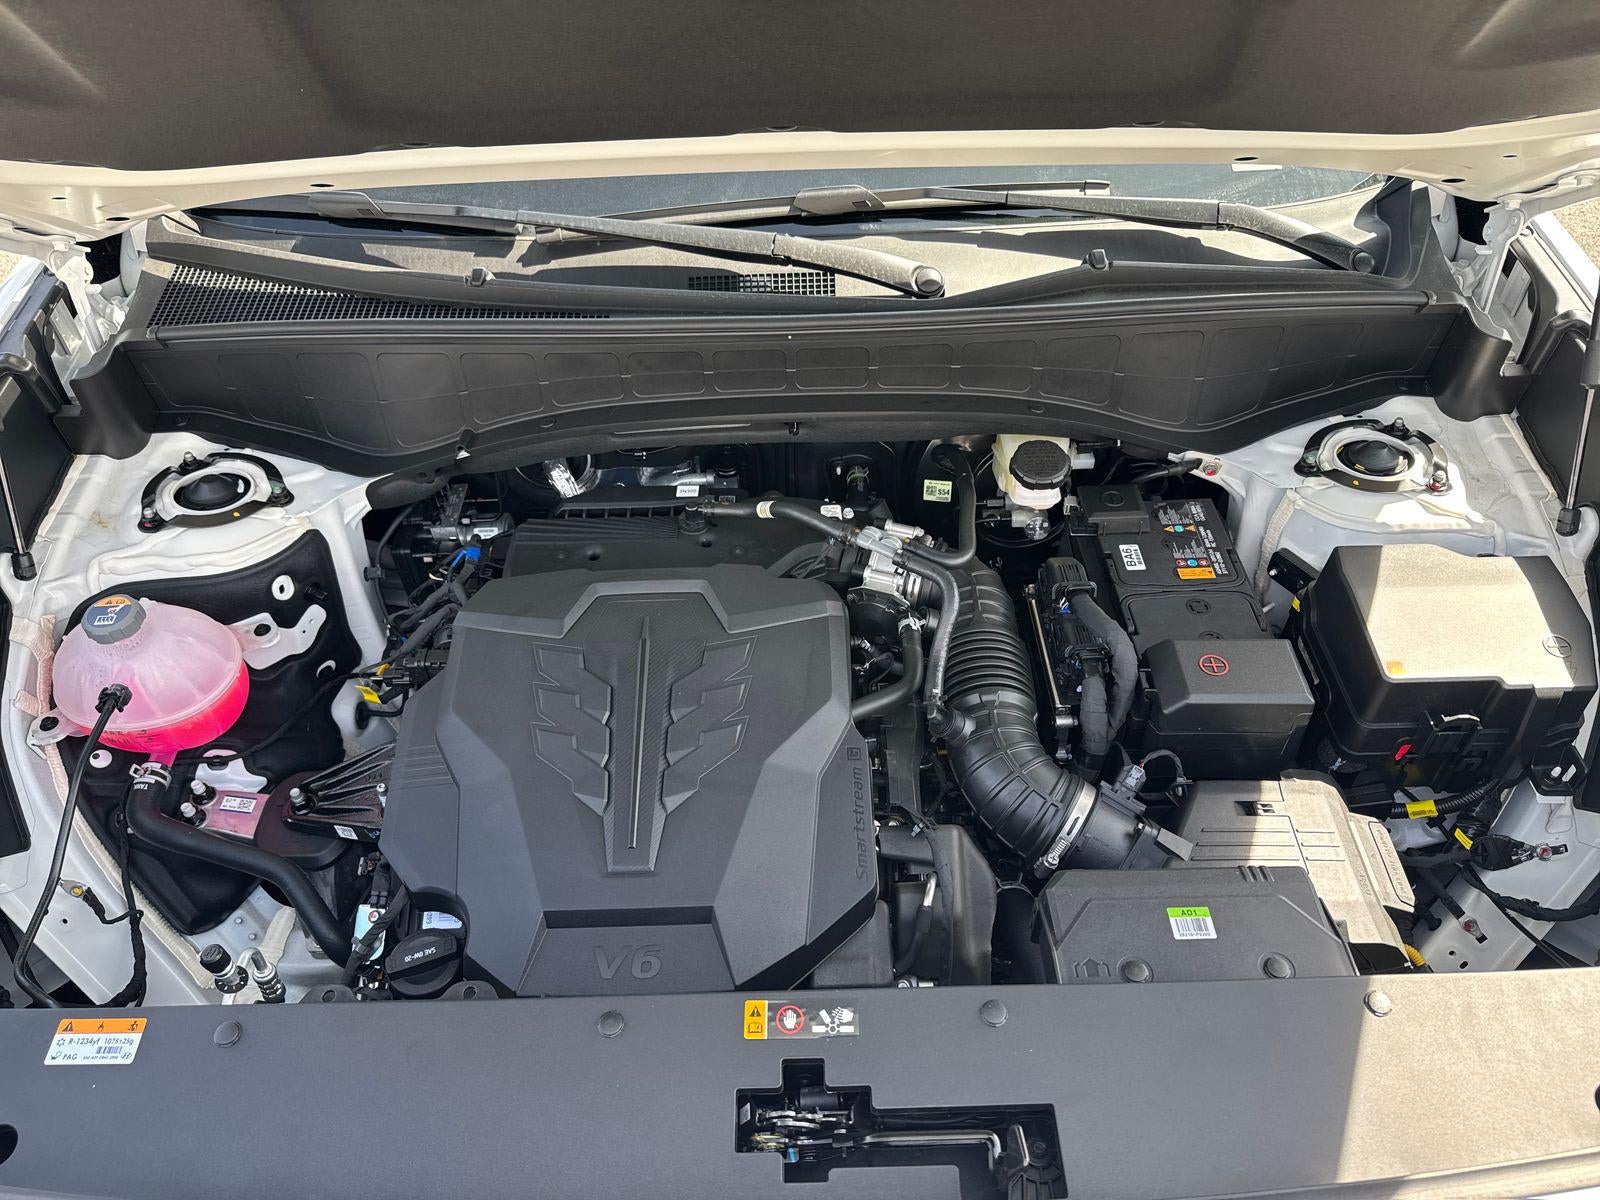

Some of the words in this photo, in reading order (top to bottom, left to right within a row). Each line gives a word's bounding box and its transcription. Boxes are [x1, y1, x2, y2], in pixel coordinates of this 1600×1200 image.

[1121, 548, 1137, 567] BA6
[853, 766, 869, 881] Smartstream
[404, 951, 424, 963] 0W-20
[424, 946, 437, 956] SAE
[592, 943, 663, 980] V6
[67, 1037, 101, 1047] R-1234yf
[62, 1053, 78, 1061] PAG
